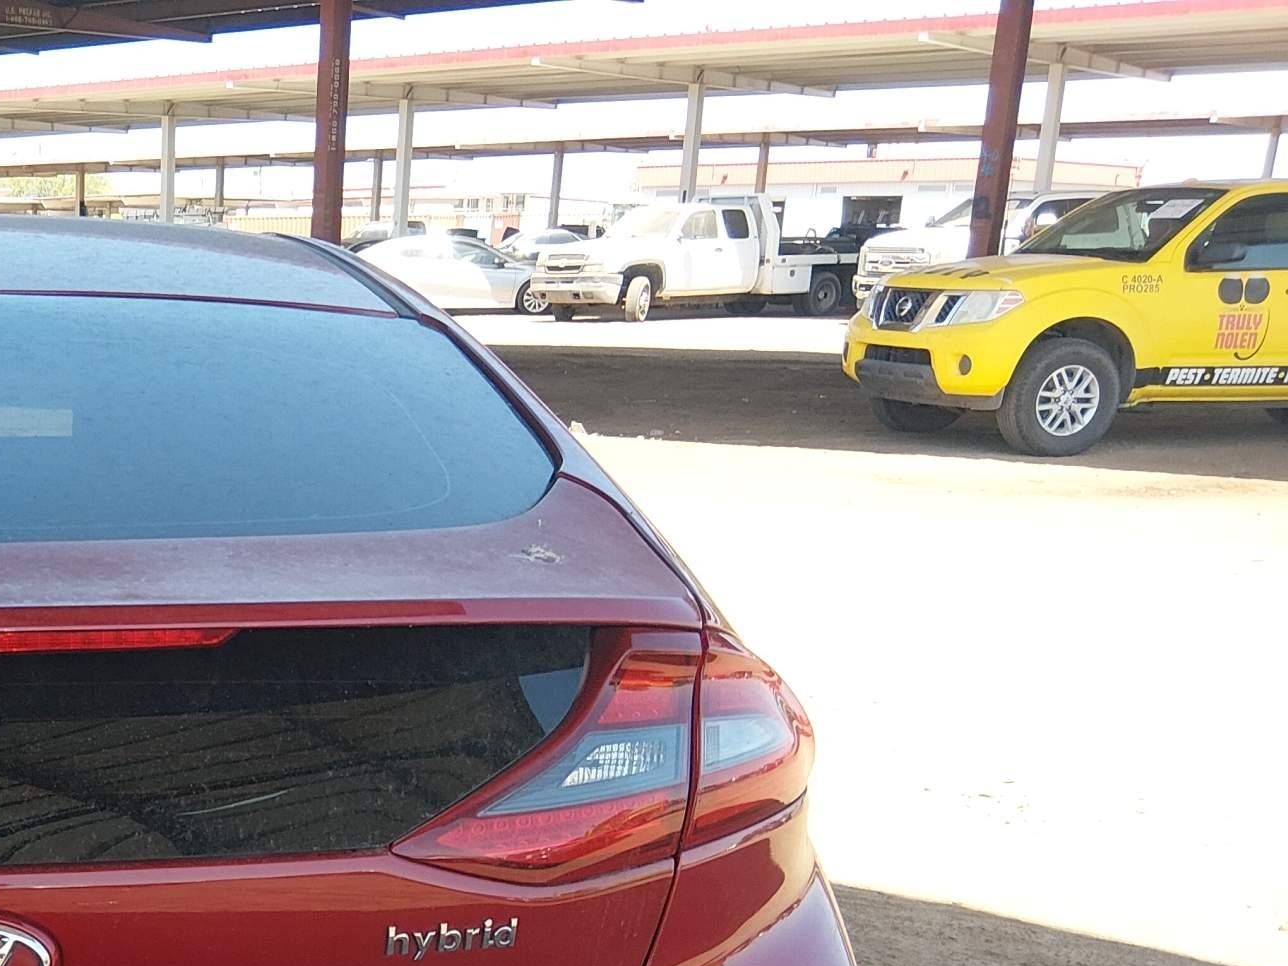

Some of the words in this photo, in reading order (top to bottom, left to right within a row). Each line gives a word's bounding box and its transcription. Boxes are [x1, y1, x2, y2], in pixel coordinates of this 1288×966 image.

[1122, 275, 1128, 284] C
[1131, 275, 1163, 284] 4020-A
[1122, 283, 1160, 293] PRO285
[1218, 313, 1263, 331] TRULY
[1215, 332, 1258, 350] NOLEN
[1165, 368, 1206, 385] PEST
[1211, 367, 1279, 385] TERMITE
[386, 917, 519, 961] hybrid
